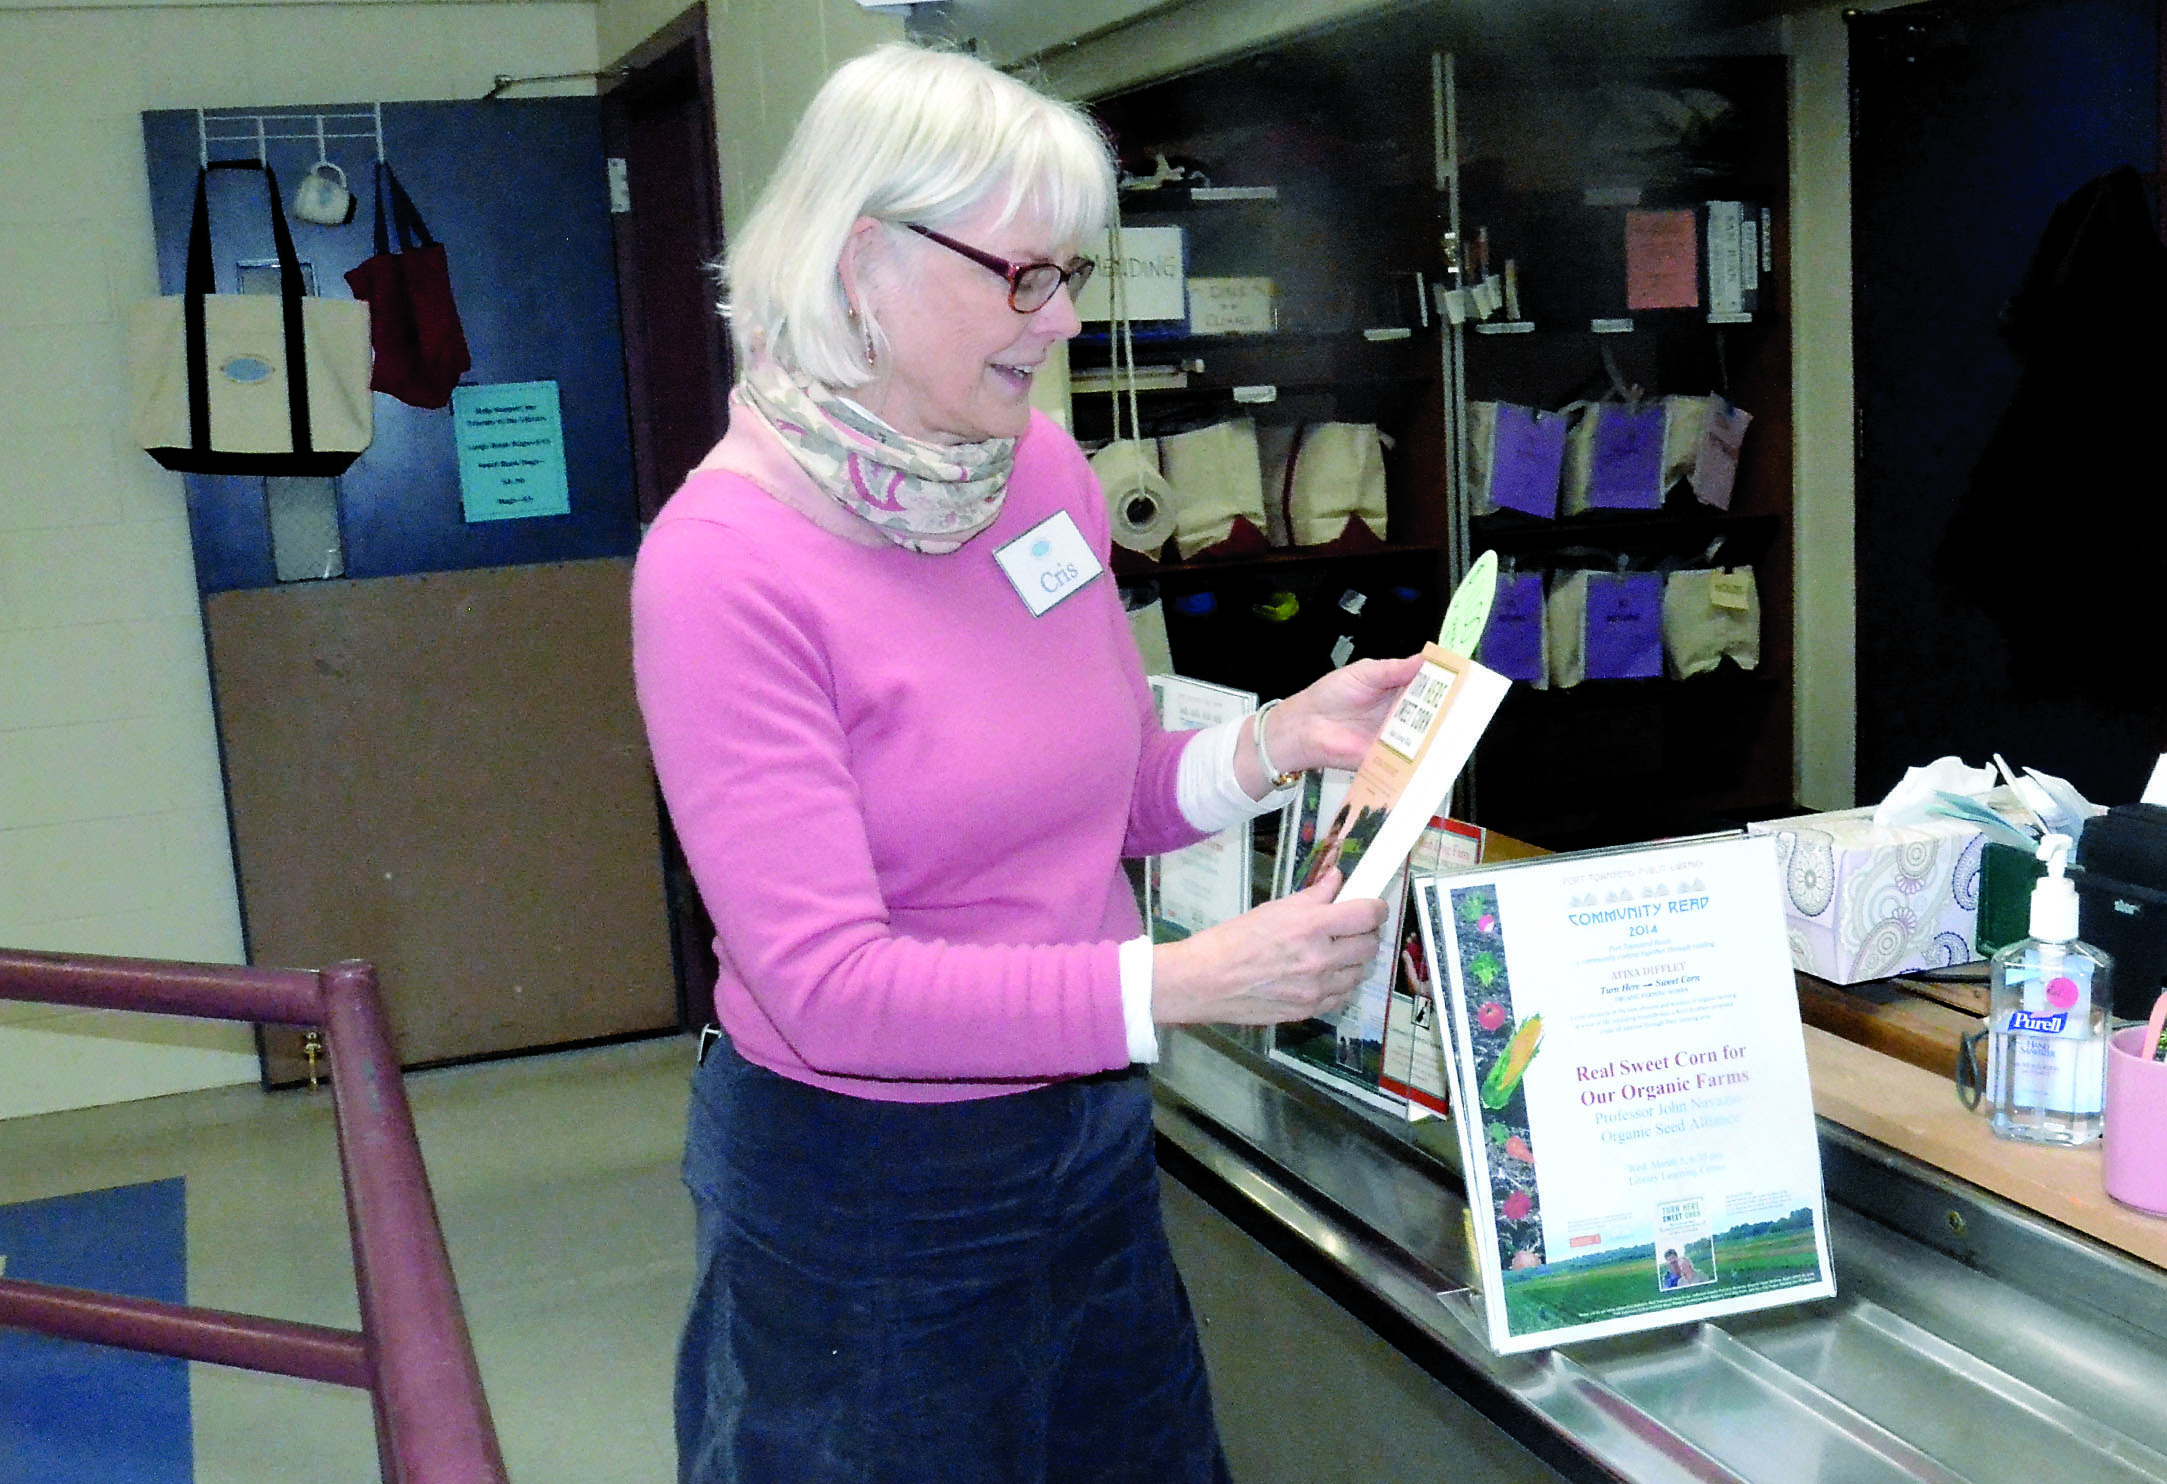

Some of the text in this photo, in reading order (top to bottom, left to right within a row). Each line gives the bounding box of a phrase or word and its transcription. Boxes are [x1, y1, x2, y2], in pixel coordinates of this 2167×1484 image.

[1040, 562, 1079, 593] Cris
[1568, 896, 1710, 927] COMMUNITY READ
[1629, 924, 1658, 937] 2014
[1600, 974, 1701, 995] Turn Here Sweet Corn
[2013, 1013, 2062, 1032] Purell
[1576, 1044, 1748, 1083] Real Sweet Corn for
[1580, 1069, 1751, 1107] Our Organic Farms
[1595, 1105, 1655, 1125] Professor
[1657, 1100, 1688, 1117] John
[1600, 1125, 1652, 1145] Organic
[1655, 1119, 1686, 1136] Seed
